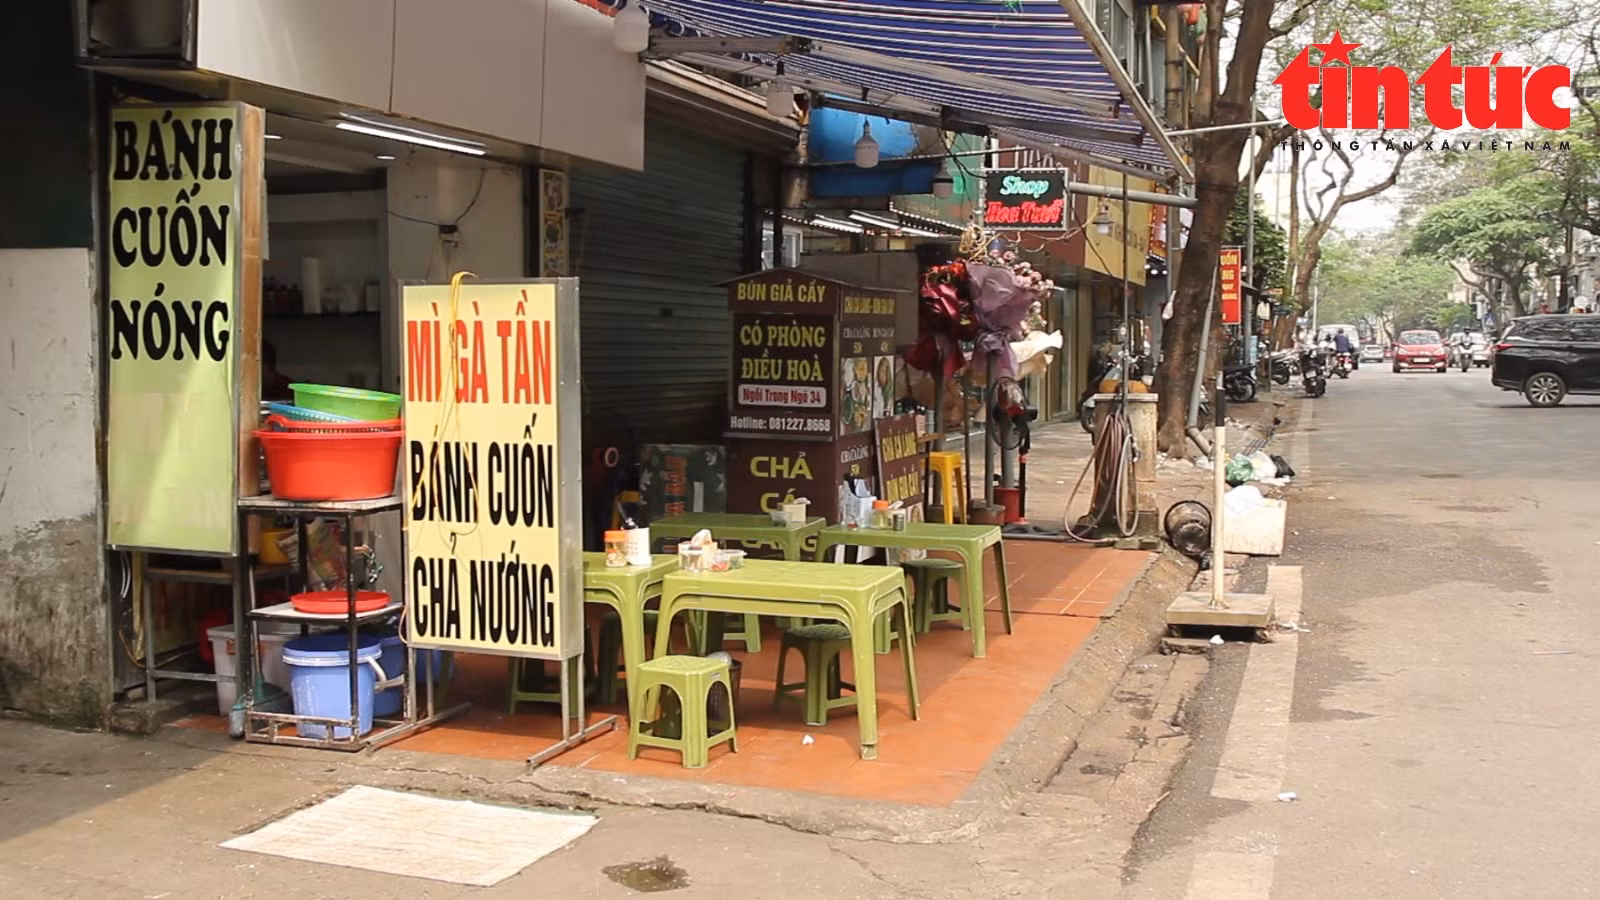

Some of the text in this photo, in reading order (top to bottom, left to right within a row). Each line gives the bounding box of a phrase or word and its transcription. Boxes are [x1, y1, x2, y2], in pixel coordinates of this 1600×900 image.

[113, 109, 233, 181] BÁNH
[1000, 175, 1049, 199] Shop
[113, 182, 229, 267] CUỐN
[737, 280, 767, 301] BÚN
[770, 278, 794, 302] GIẢ
[111, 283, 229, 361] NÓNG
[740, 319, 763, 346] CÓ
[767, 319, 826, 348] PHÒNG
[407, 289, 552, 405] MÌ GÀ TẦN
[741, 348, 824, 381] ĐIỀU HOÀ
[765, 389, 789, 404] Trong
[730, 415, 768, 429] Hotline:
[410, 424, 479, 523] BÁNH
[488, 413, 553, 528] CUỐN
[750, 451, 813, 480] CHẢ
[760, 488, 798, 514] CÁ
[413, 532, 555, 648] CHẢ NƯỚNG
